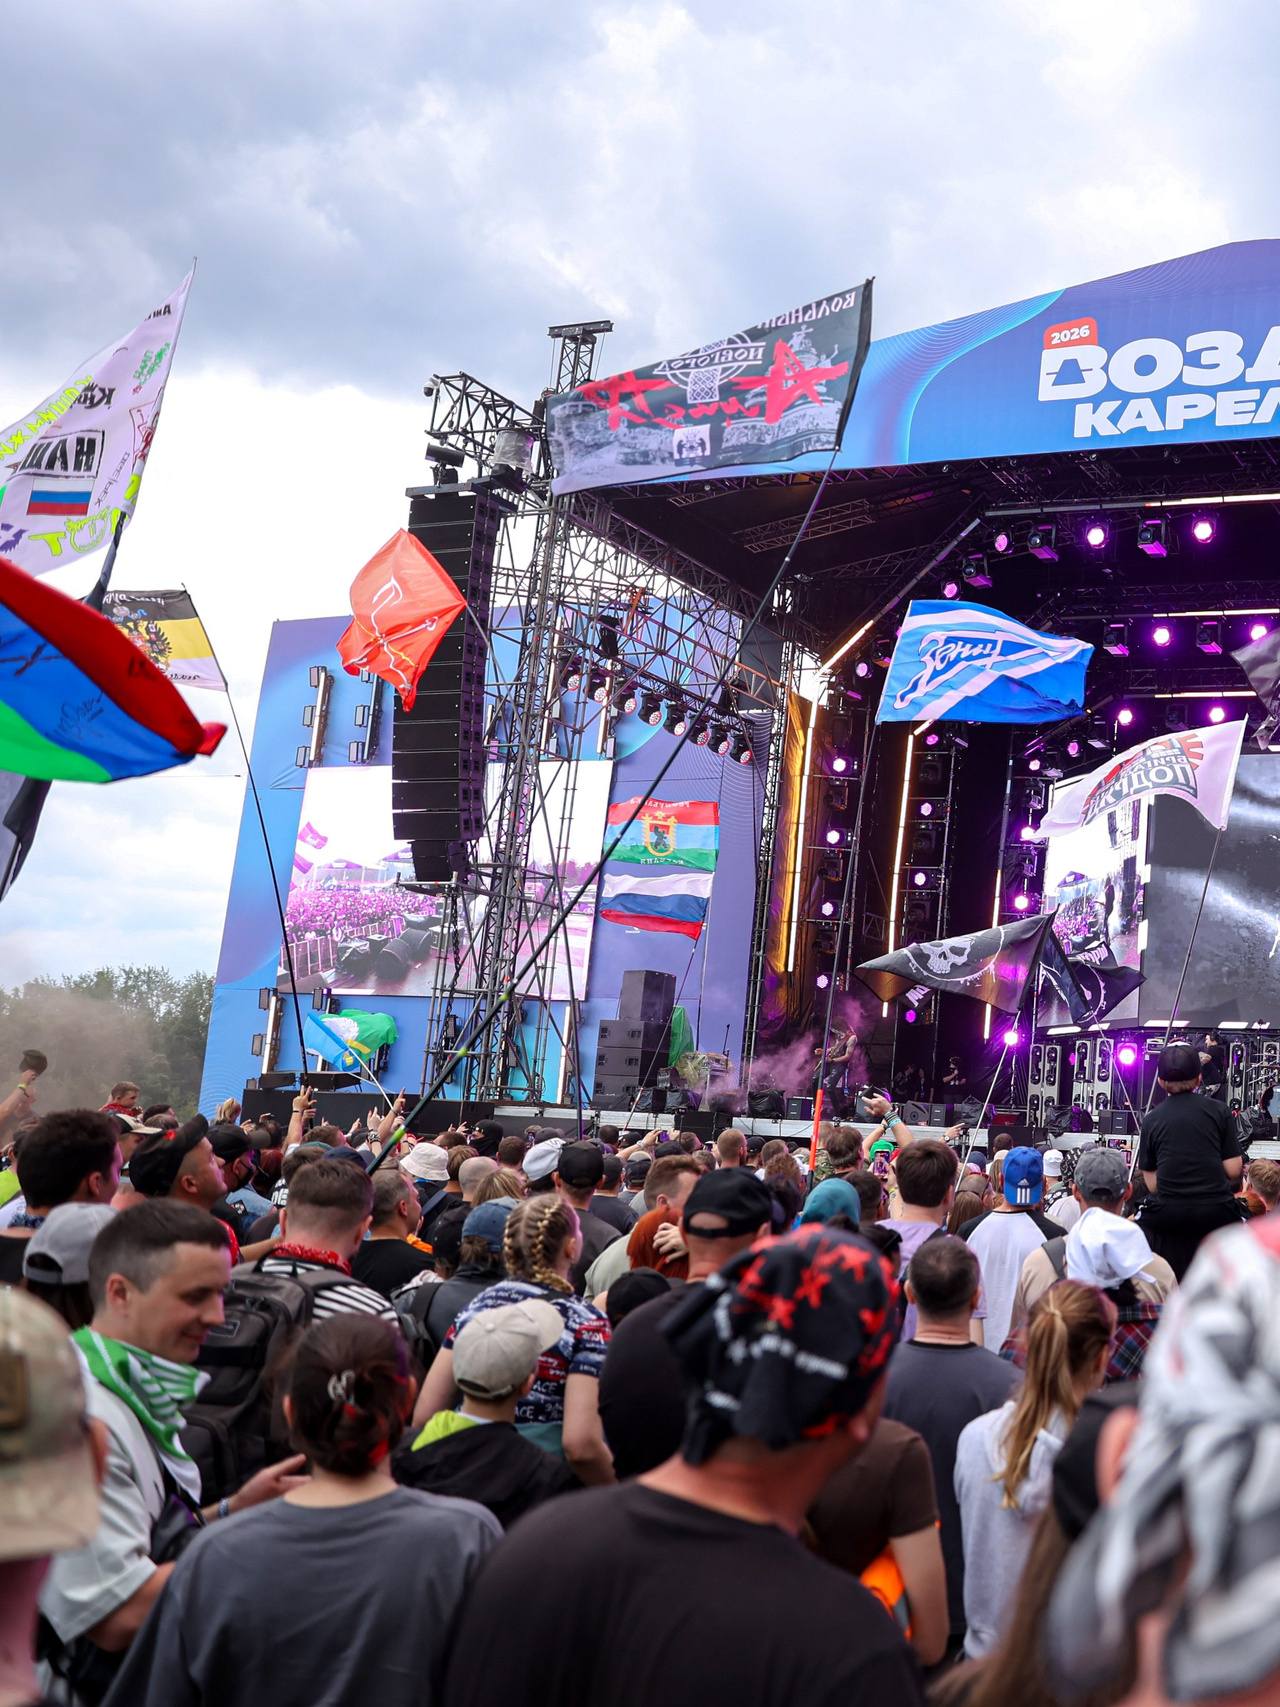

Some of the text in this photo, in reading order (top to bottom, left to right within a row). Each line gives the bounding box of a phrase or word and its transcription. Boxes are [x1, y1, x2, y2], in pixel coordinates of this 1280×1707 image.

[1050, 324, 1090, 346] 2026
[533, 1381, 558, 1395] ACE
[514, 1405, 535, 1419] ACE
